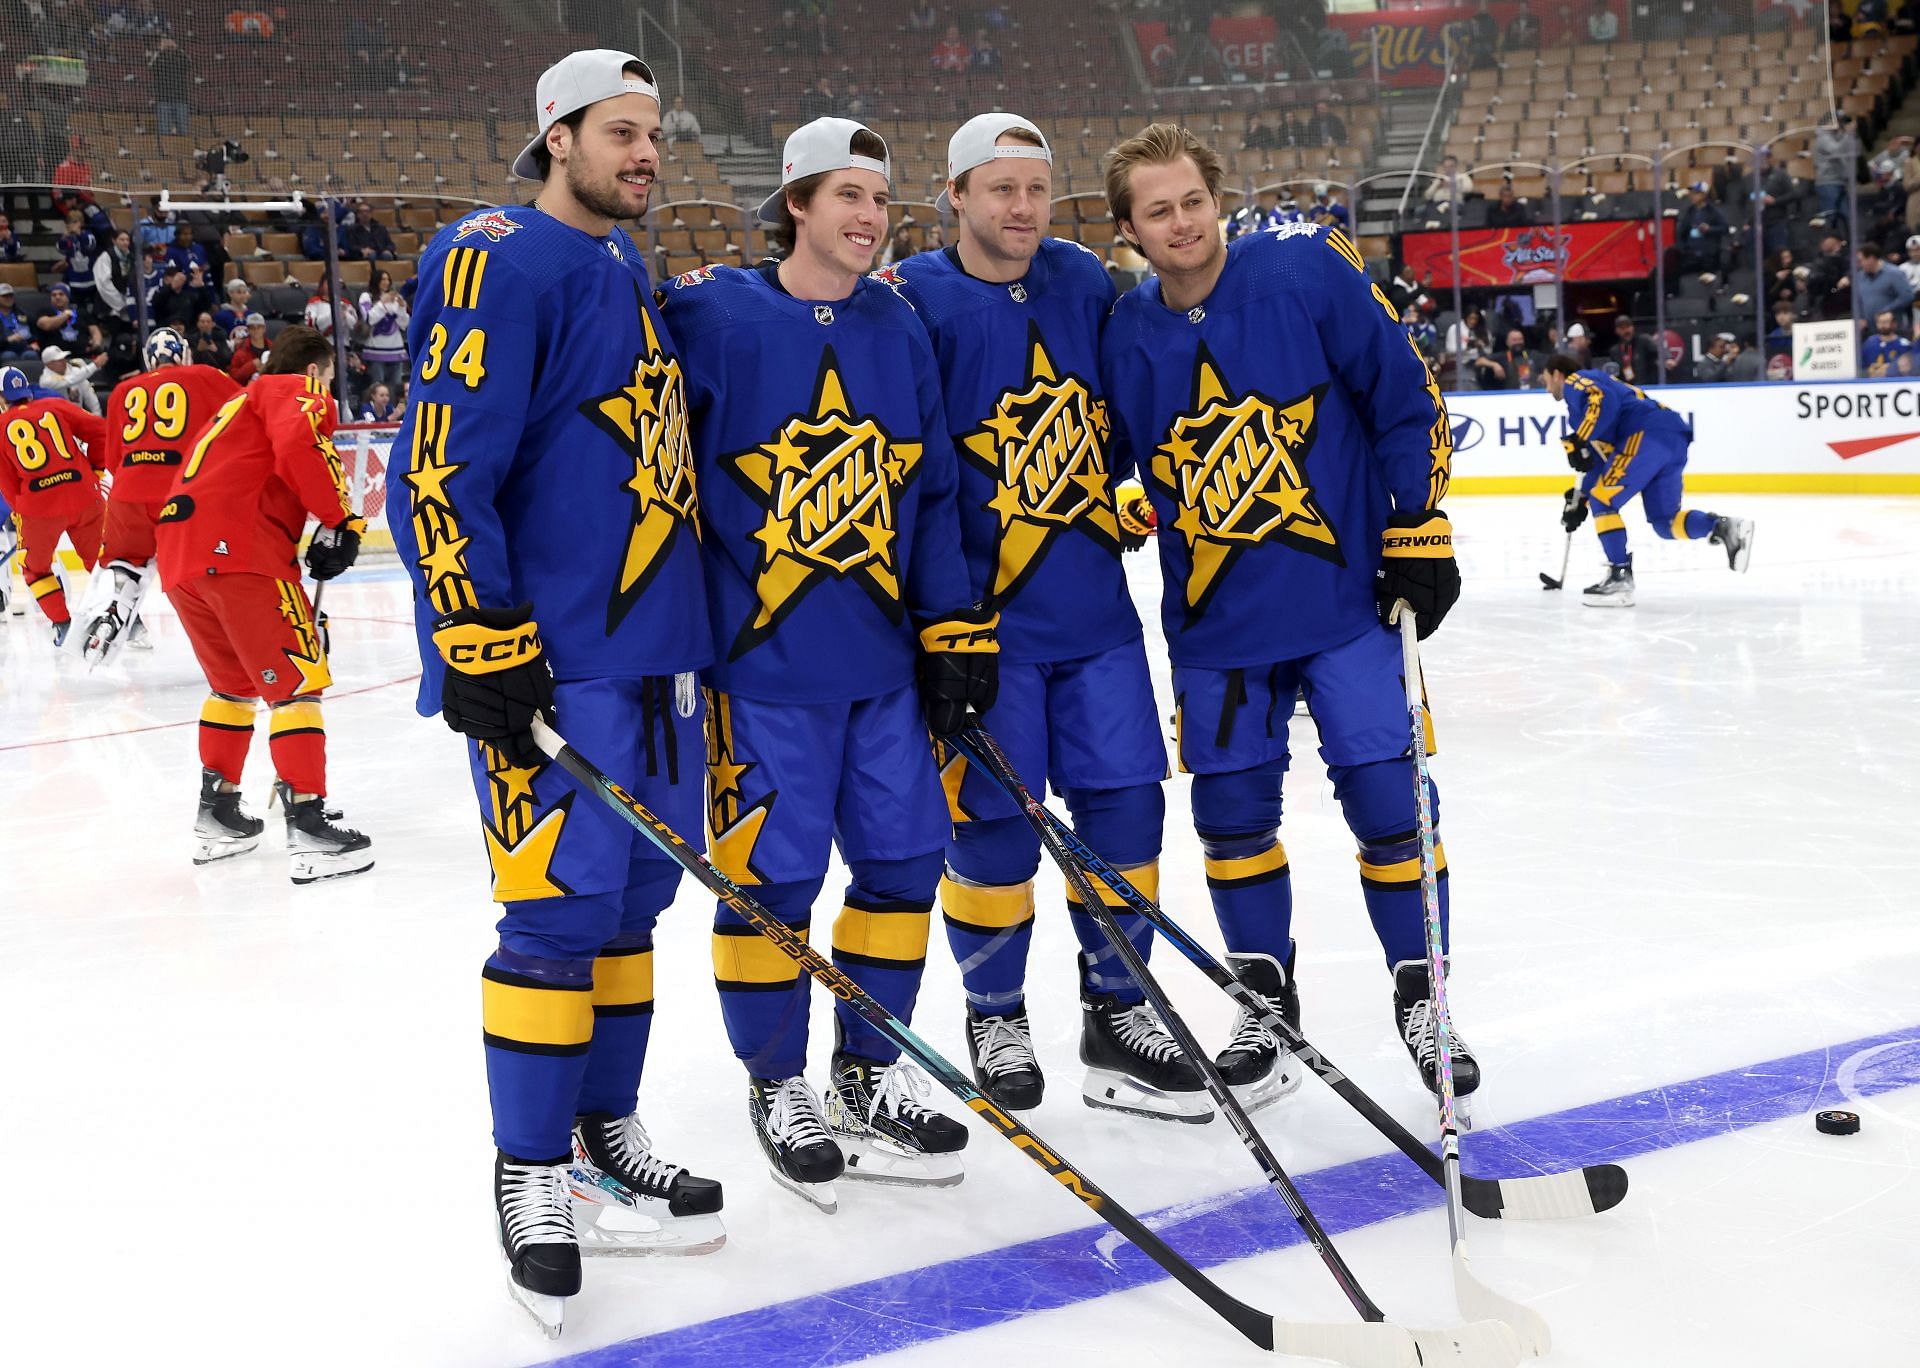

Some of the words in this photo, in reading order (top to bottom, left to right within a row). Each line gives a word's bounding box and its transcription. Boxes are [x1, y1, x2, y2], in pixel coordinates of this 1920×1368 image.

[421, 322, 487, 390] 34
[123, 382, 187, 442] 39
[1797, 388, 1920, 418] SPORTC
[7, 411, 72, 471] 81
[131, 451, 166, 464] talbot
[657, 388, 682, 490] NHL
[1024, 406, 1083, 504] NHL
[38, 471, 74, 489] connor
[799, 448, 875, 542] NHL
[1202, 425, 1270, 524] NHL
[450, 630, 541, 664] CCM
[609, 783, 686, 846] CCM
[708, 865, 729, 884] PAPI
[728, 881, 740, 893] 34
[1050, 818, 1134, 898] TSPEED
[710, 887, 852, 1000] JETSPEED
[1223, 980, 1347, 1086] CCM
[965, 1097, 1105, 1211] CCM
